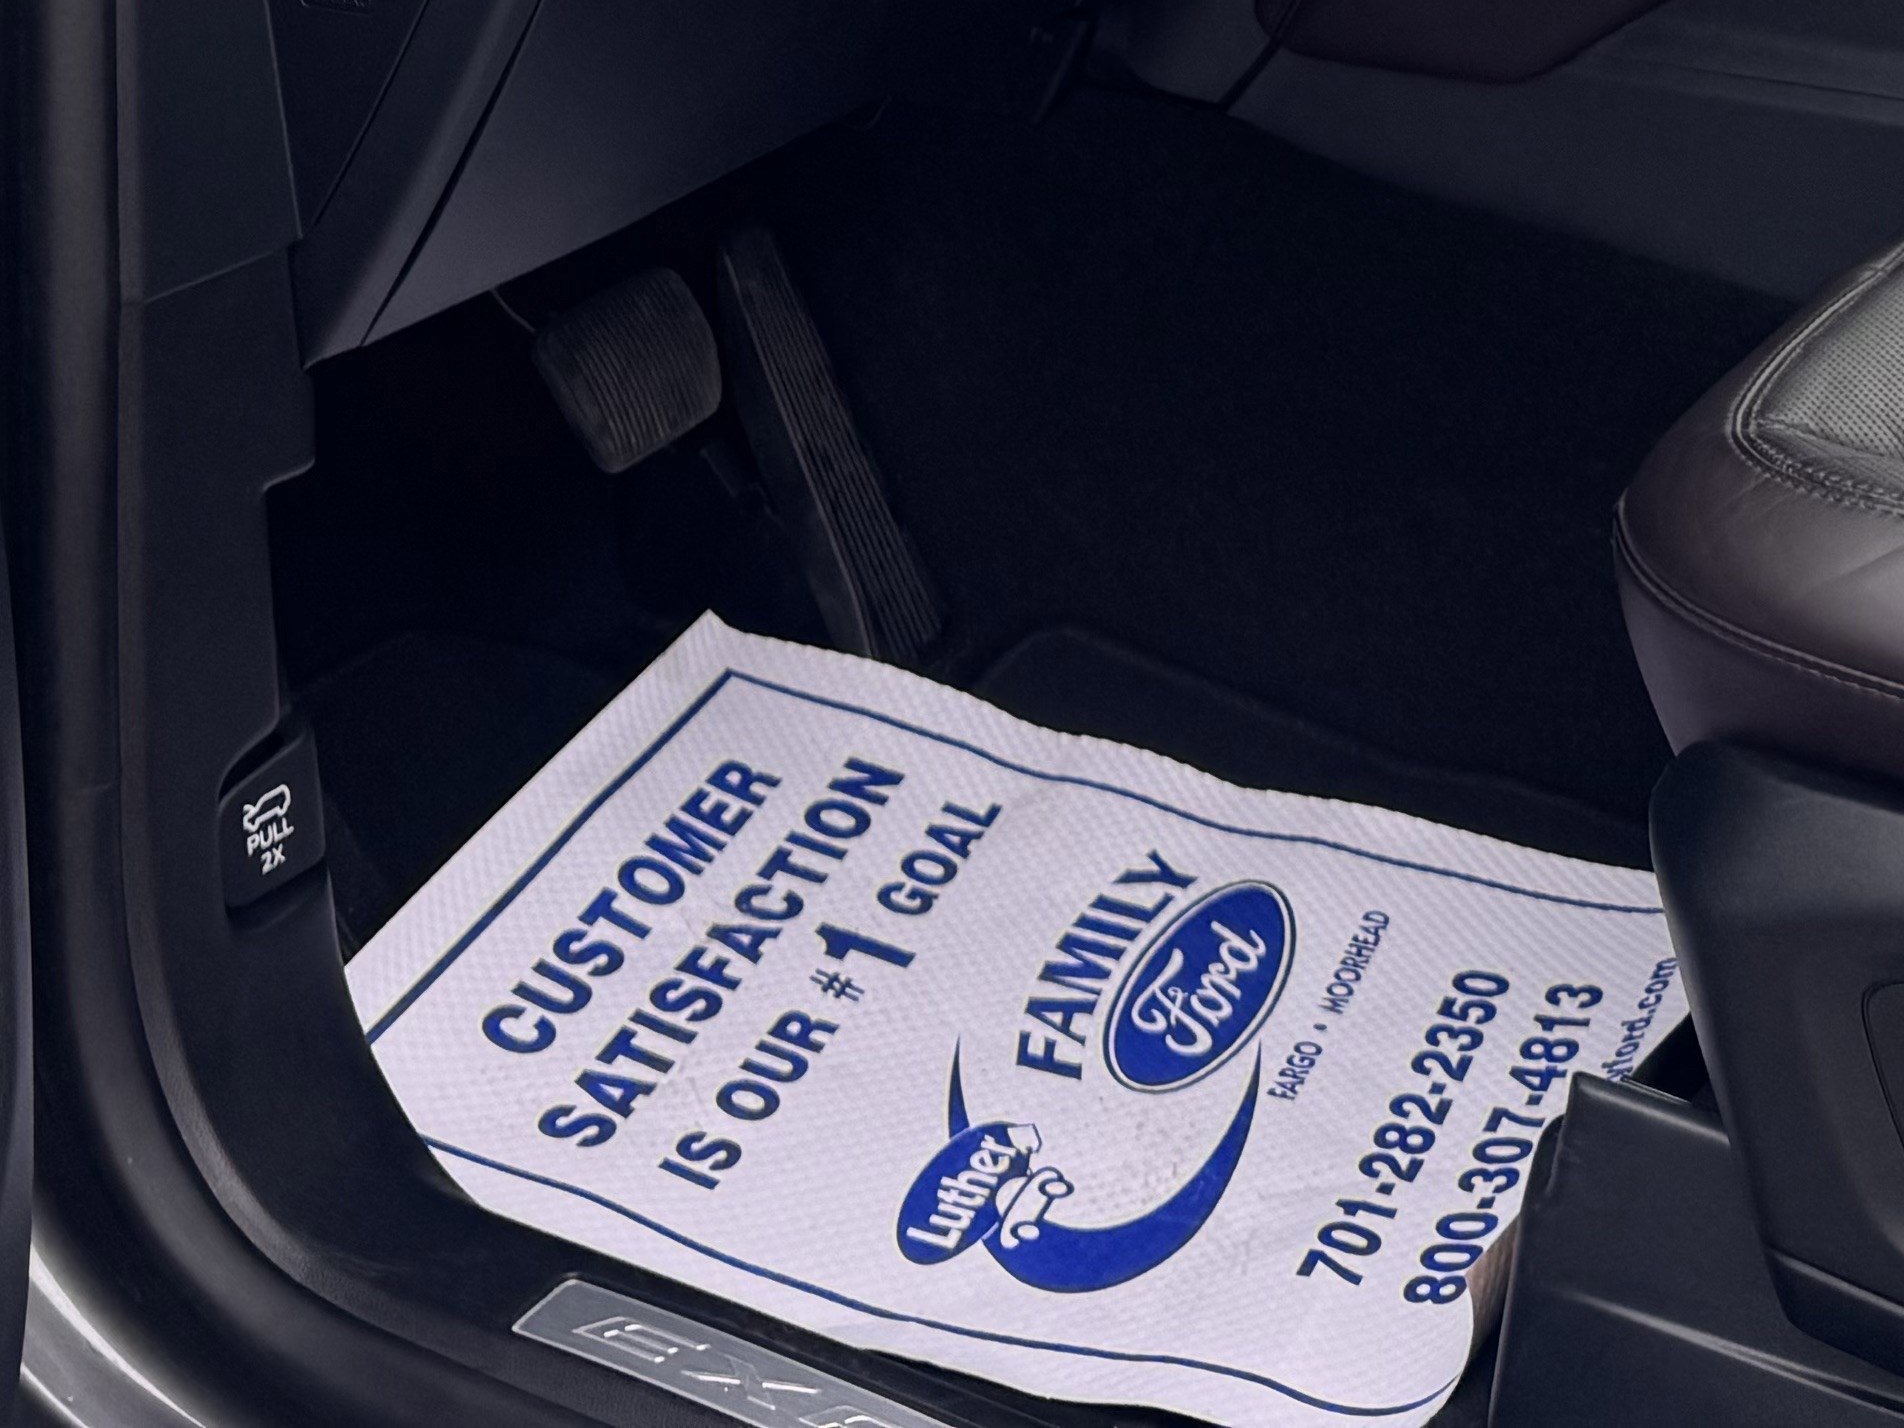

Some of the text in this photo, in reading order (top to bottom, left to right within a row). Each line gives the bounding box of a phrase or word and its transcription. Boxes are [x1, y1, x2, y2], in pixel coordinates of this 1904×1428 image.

[246, 817, 294, 857] PULL
[260, 843, 286, 875] 2X
[482, 759, 783, 1055] CUSTOMER
[538, 757, 906, 1147] SATISFACTION
[658, 1130, 742, 1190] IS
[716, 1010, 840, 1121] OUR
[876, 801, 1003, 915] GOAL
[1016, 849, 1199, 1081] FAMILY
[1131, 920, 1268, 1057] Ford
[1267, 909, 1390, 1101] FARGO MOORHEAD
[906, 1133, 1017, 1250] Luther
[1296, 969, 1511, 1286] 701-282-2350
[1402, 982, 1603, 1306] 800-307-4813
